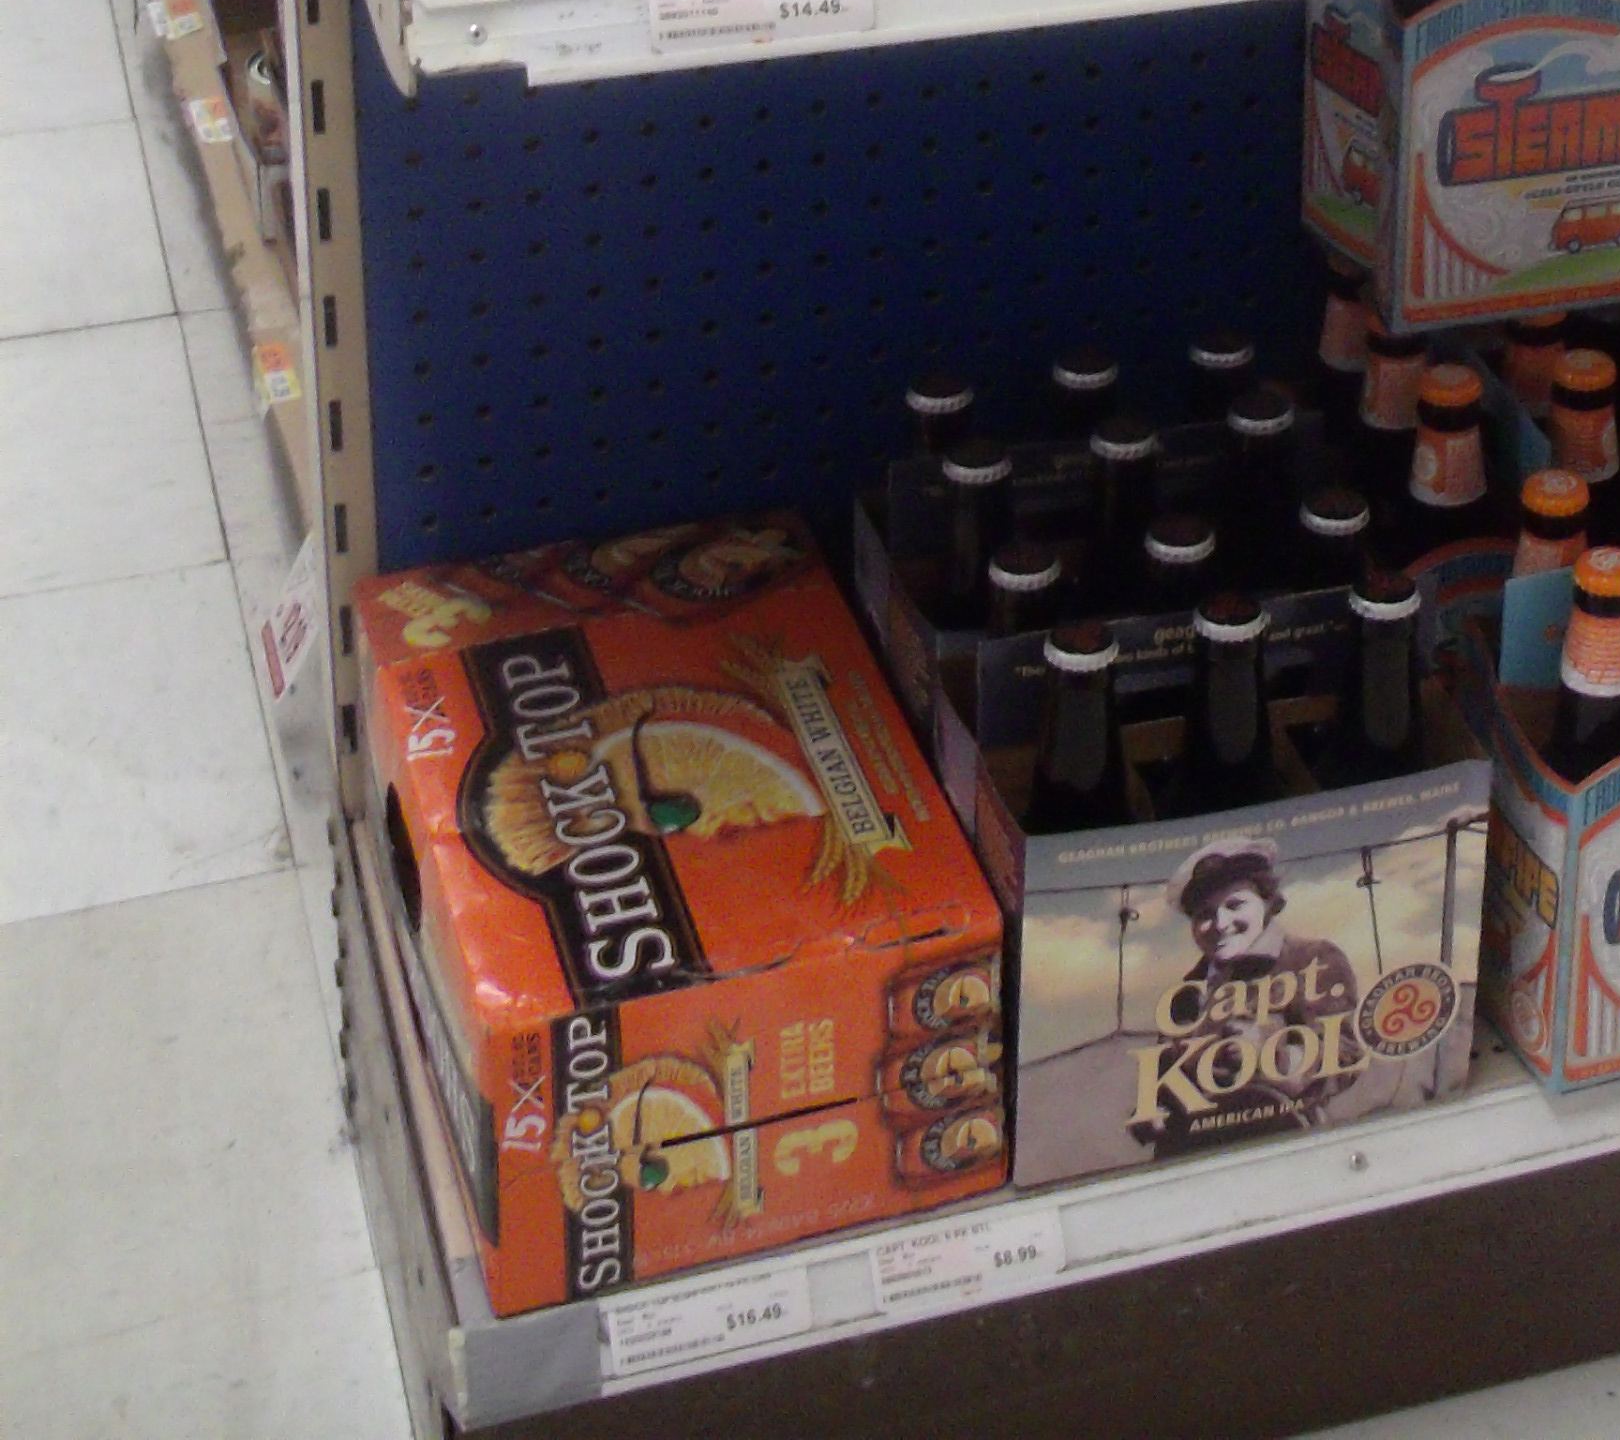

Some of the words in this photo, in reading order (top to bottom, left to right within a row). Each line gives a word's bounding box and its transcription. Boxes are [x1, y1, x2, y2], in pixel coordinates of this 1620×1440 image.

[779, 0, 842, 19] $14.49
[504, 654, 592, 761] TOP
[791, 678, 830, 740] WHITE
[824, 747, 876, 835] BELGIAN
[1058, 845, 1123, 864] GEAGHAN
[1130, 836, 1200, 855] BROTHERS
[1291, 807, 1344, 827] BANGOR
[1420, 782, 1459, 802] MAINE
[541, 766, 675, 979] SHOCK
[1155, 957, 1346, 1037] Capt.
[566, 1017, 608, 1112] TOP
[729, 1066, 744, 1119] WHITE
[779, 1022, 807, 1099] EXTRA
[808, 1018, 836, 1094] BEERS
[1128, 1013, 1370, 1125] KOOL
[773, 1120, 859, 1176] 3
[1189, 1105, 1275, 1133] AMERICAN
[572, 1125, 621, 1290] SHOCK
[737, 1136, 752, 1202] BELGIAN
